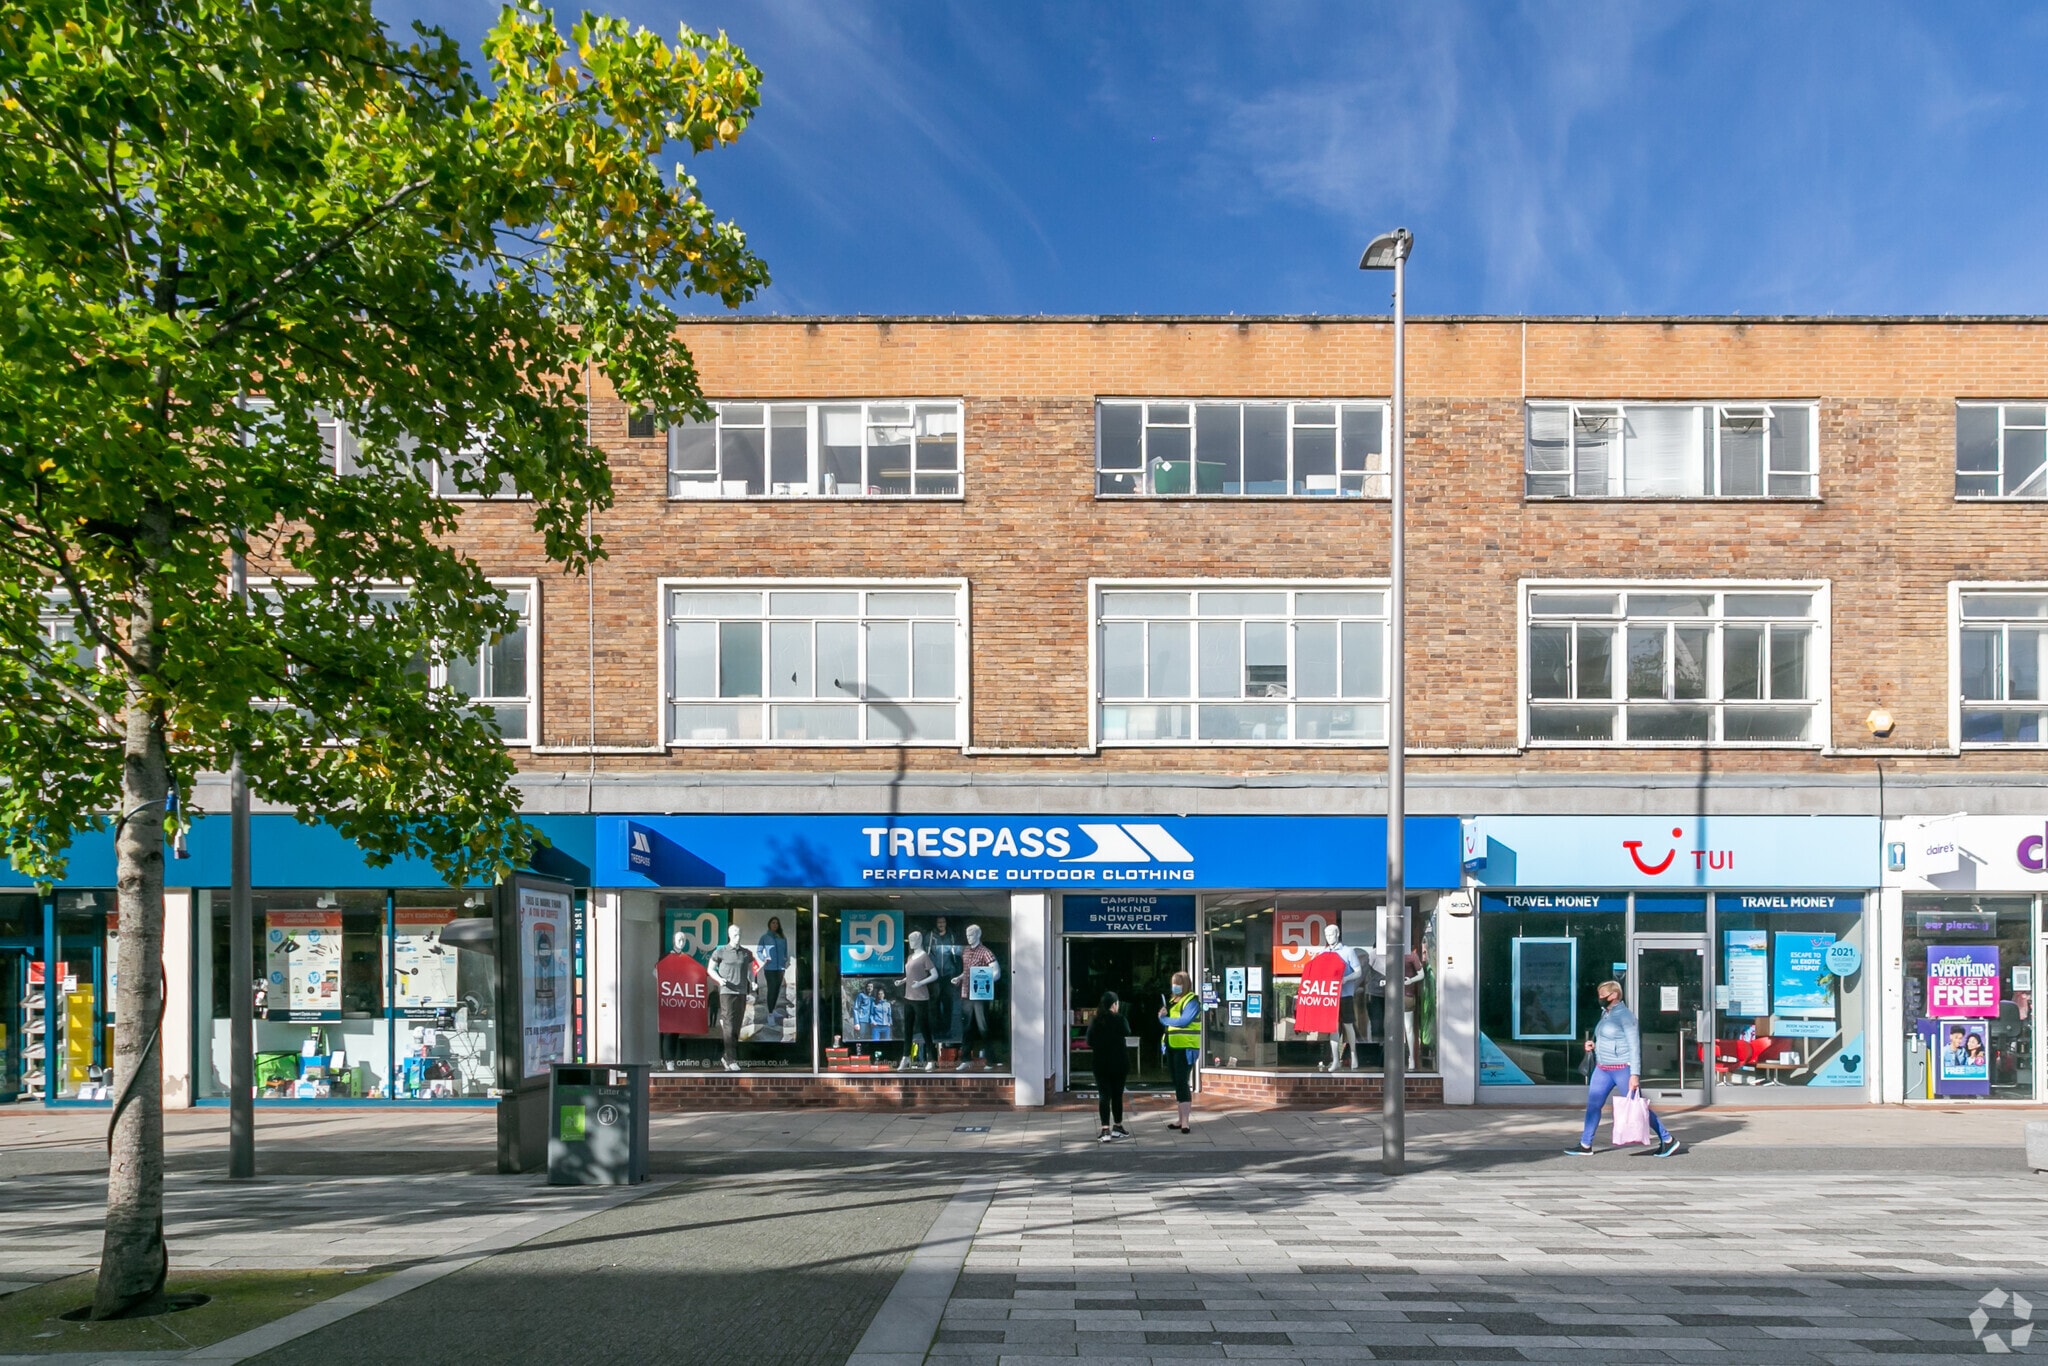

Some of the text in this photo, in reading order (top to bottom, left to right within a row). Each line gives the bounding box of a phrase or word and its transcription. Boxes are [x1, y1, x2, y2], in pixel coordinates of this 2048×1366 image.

[862, 827, 1070, 857] TRESPASS
[1926, 842, 1954, 856] claire's
[630, 852, 651, 867] TRESPASS
[1691, 850, 1734, 870] TUI
[862, 869, 1195, 880] PERFORMANCE OUTDOOR CLOTHING
[1505, 895, 1600, 907] TRAVEL MONEY
[1740, 896, 1836, 908] TRAVEL MONEY
[1089, 914, 1168, 922] SNOWSPORT
[1924, 921, 1943, 929] ear
[1106, 923, 1152, 931] TRAVEL
[673, 912, 719, 957] 50
[848, 914, 895, 961] 50
[1281, 914, 1327, 962] 50
[1931, 963, 1996, 977] EVERYTHING
[1300, 980, 1340, 996] SALE
[1938, 977, 1989, 986] BUY 3 GET 3
[661, 981, 705, 998] SALE
[1933, 985, 1994, 1006] FREE
[660, 998, 706, 1009] NOW ON
[1299, 996, 1337, 1007] NOW ON
[598, 1088, 620, 1096] Litter
